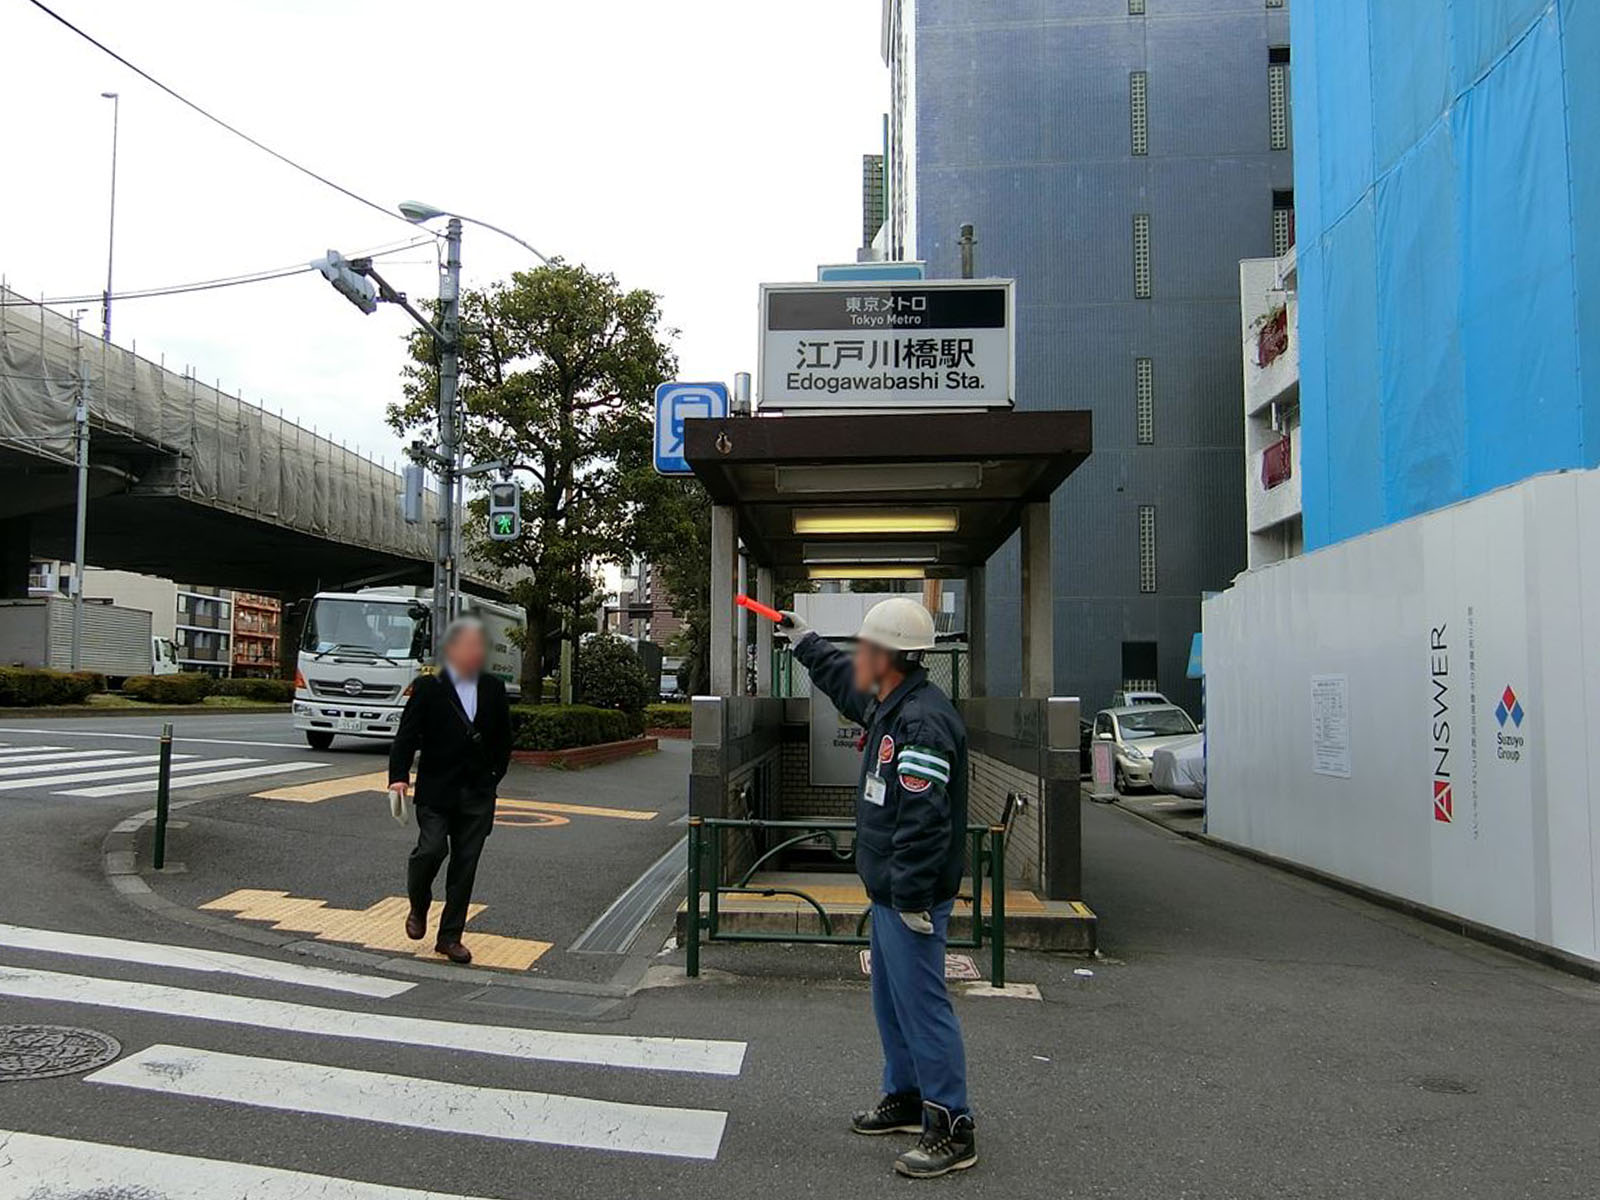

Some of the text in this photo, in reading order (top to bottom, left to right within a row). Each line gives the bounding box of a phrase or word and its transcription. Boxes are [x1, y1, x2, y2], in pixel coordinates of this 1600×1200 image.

[846, 296, 926, 312] 東京メトロ
[850, 314, 921, 326] Tokyo Metro
[797, 338, 975, 370] 江戸川橋駅
[787, 372, 985, 393] Edogawabashi Sta.
